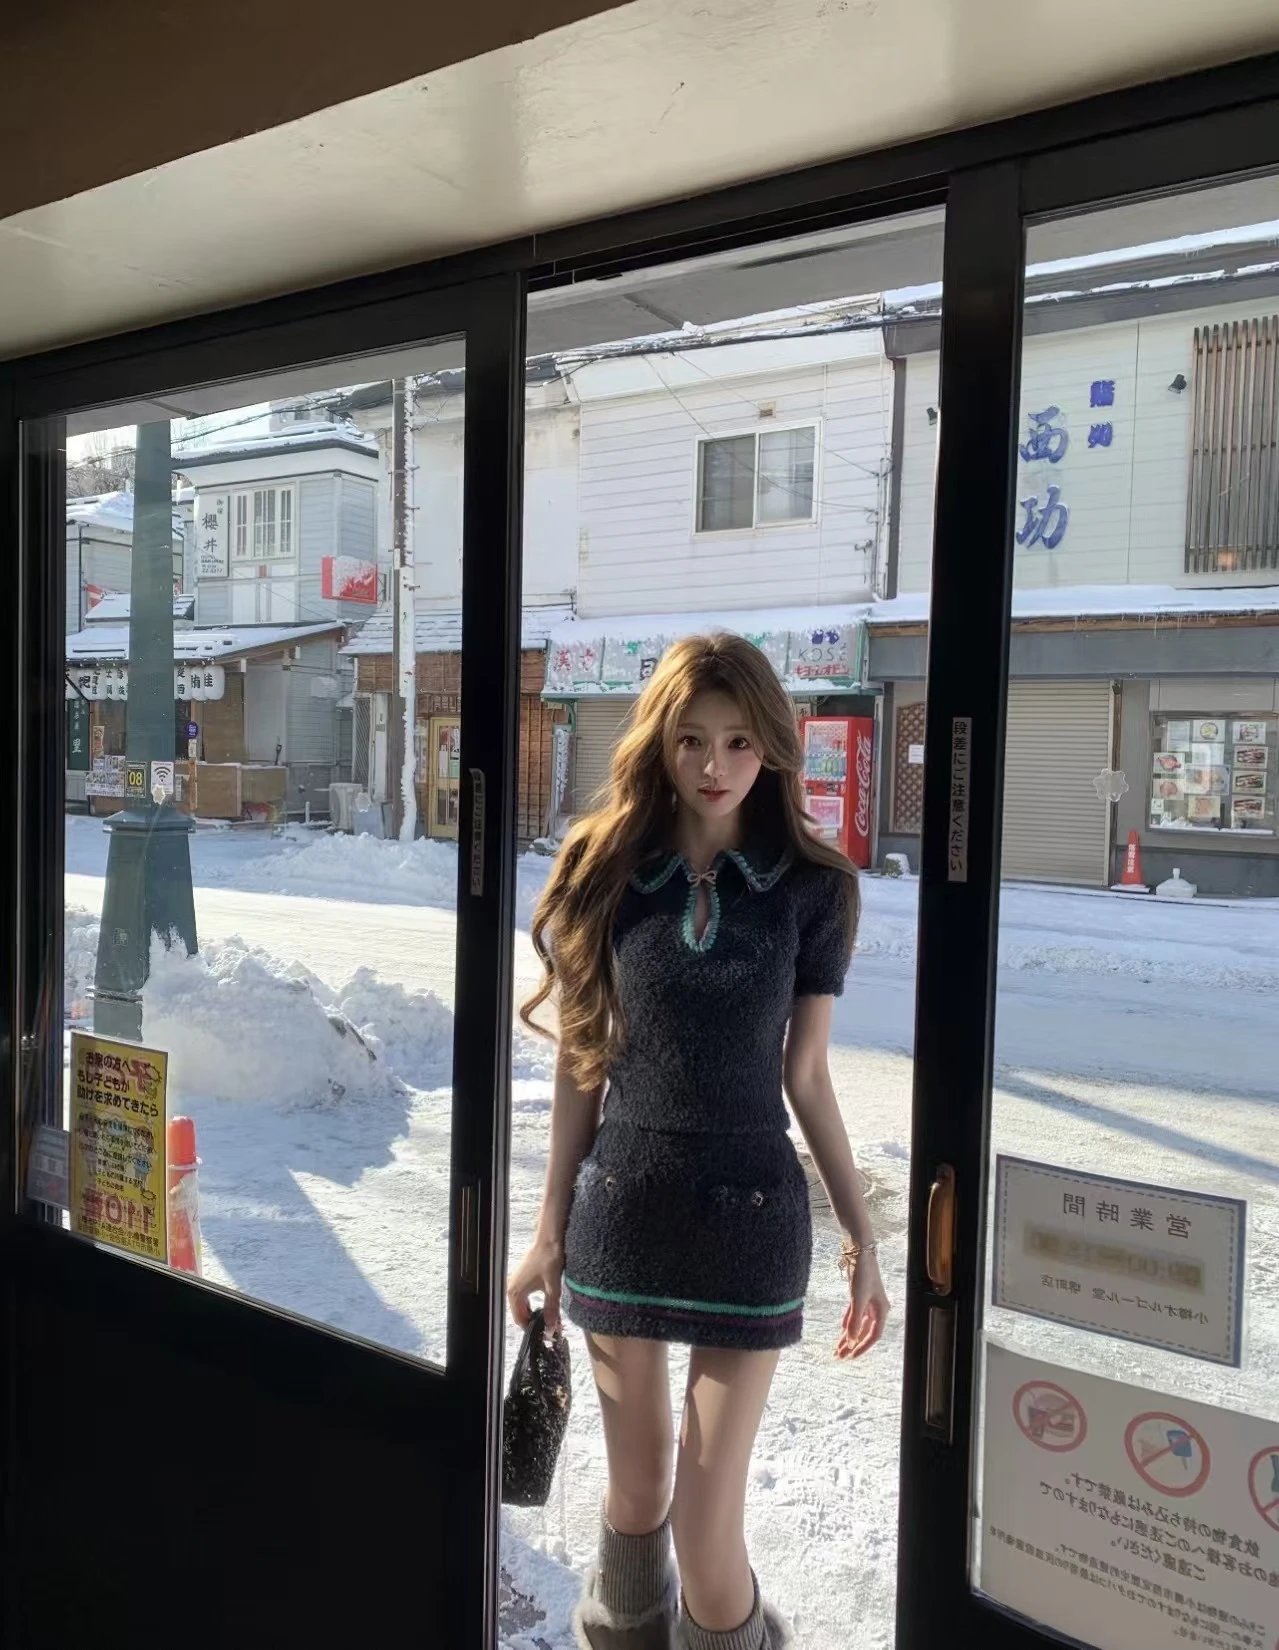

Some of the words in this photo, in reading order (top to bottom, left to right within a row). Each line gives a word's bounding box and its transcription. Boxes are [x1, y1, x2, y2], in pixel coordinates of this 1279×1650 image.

[202, 513, 218, 553] 櫻井
[129, 771, 143, 786] 08
[951, 721, 968, 872] 段差にご注意ください
[77, 1069, 129, 1092] もし子どもが
[77, 1085, 159, 1117] 助けを求めてきたら
